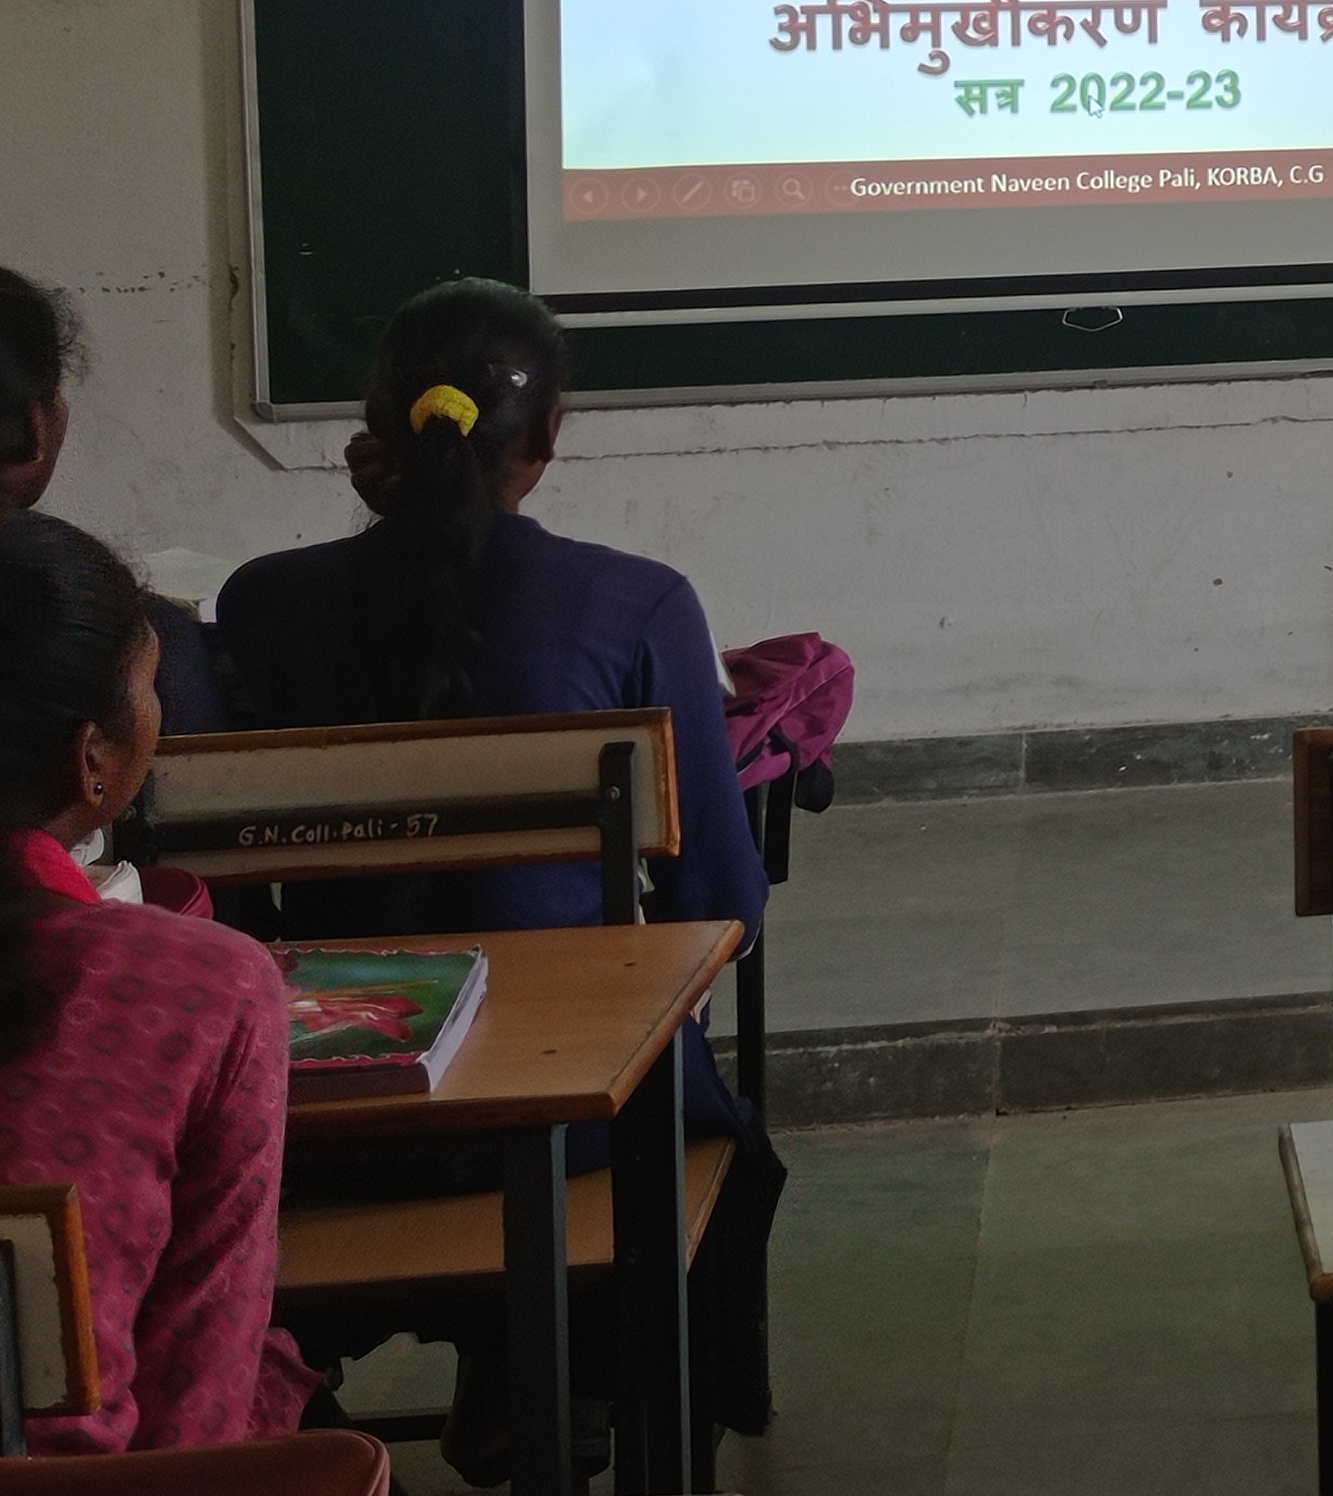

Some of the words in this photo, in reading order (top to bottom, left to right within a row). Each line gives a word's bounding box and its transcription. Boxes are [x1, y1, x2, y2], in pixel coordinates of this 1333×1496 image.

[953, 78, 1025, 117] सत्र
[1050, 68, 1242, 114] 2022-23
[850, 176, 985, 197] Government
[990, 172, 1070, 192] Naveen
[1076, 169, 1154, 194] College
[1159, 167, 1202, 191] Pali,
[1207, 166, 1284, 190] KORBA,
[1289, 164, 1325, 185] C.G
